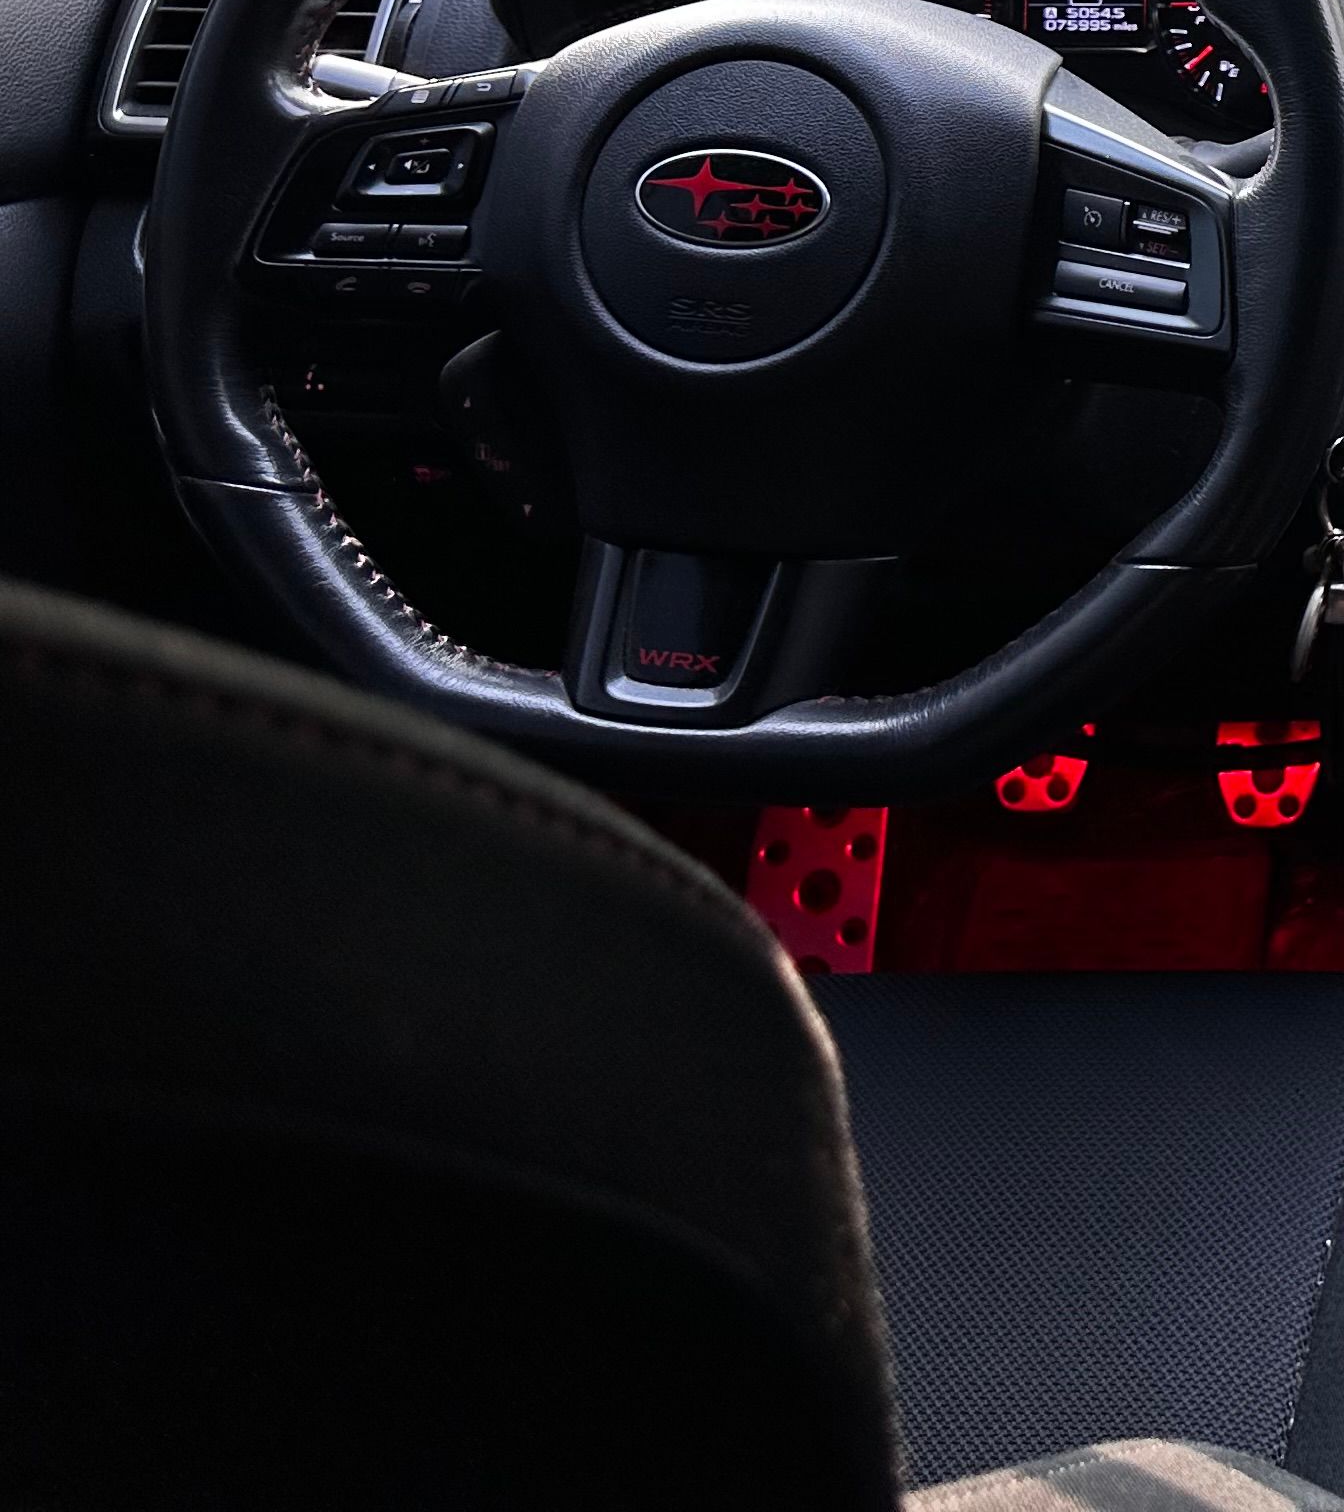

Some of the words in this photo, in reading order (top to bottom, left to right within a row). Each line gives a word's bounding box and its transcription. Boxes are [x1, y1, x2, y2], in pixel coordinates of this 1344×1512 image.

[1044, 19, 1111, 31] 075995
[330, 232, 365, 242] Source
[1099, 278, 1135, 293] CANCEL
[639, 648, 720, 673] WRX
